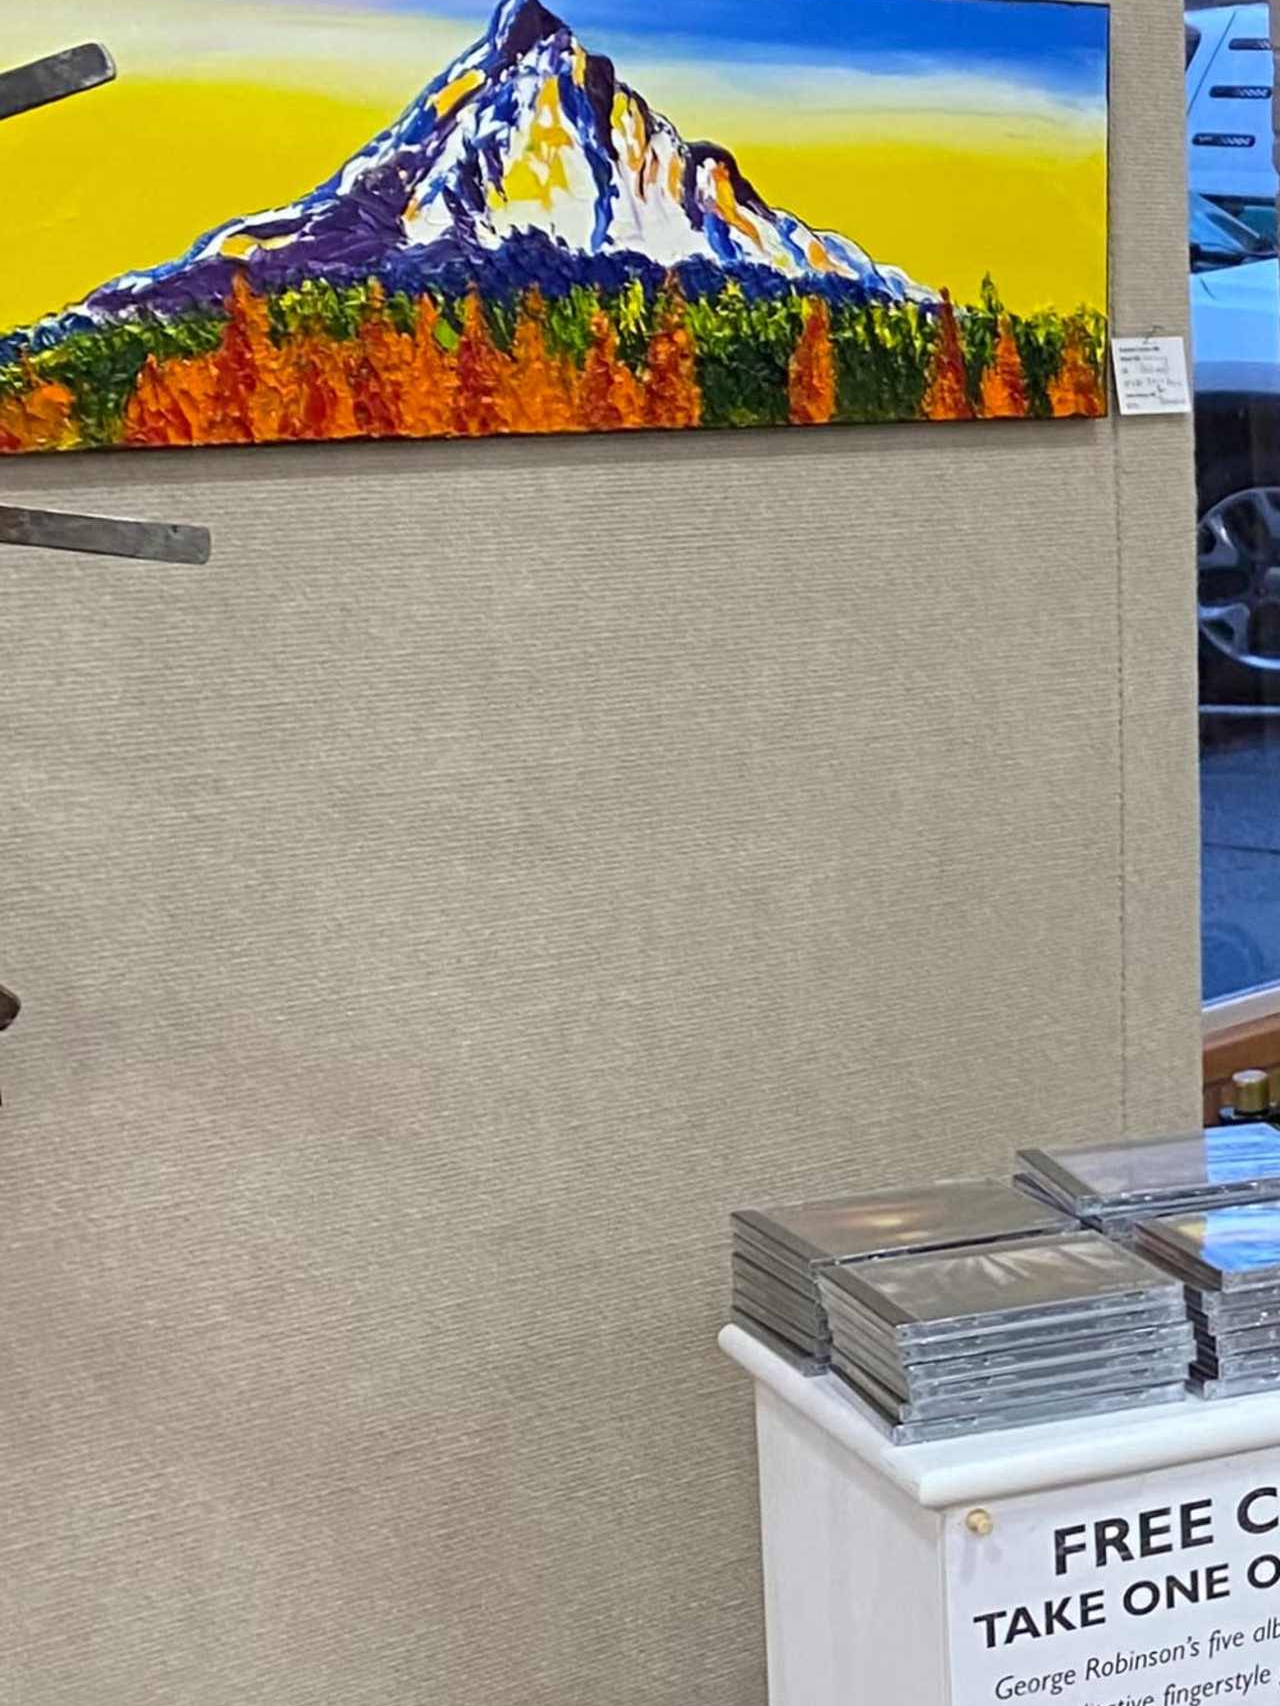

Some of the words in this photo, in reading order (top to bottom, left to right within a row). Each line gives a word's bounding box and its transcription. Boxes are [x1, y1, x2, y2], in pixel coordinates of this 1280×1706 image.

[1053, 1498, 1214, 1576] FREE
[973, 1589, 1106, 1649] TAKE
[1123, 1563, 1231, 1615] ONE
[994, 1666, 1077, 1701] George
[1208, 1628, 1245, 1659] five
